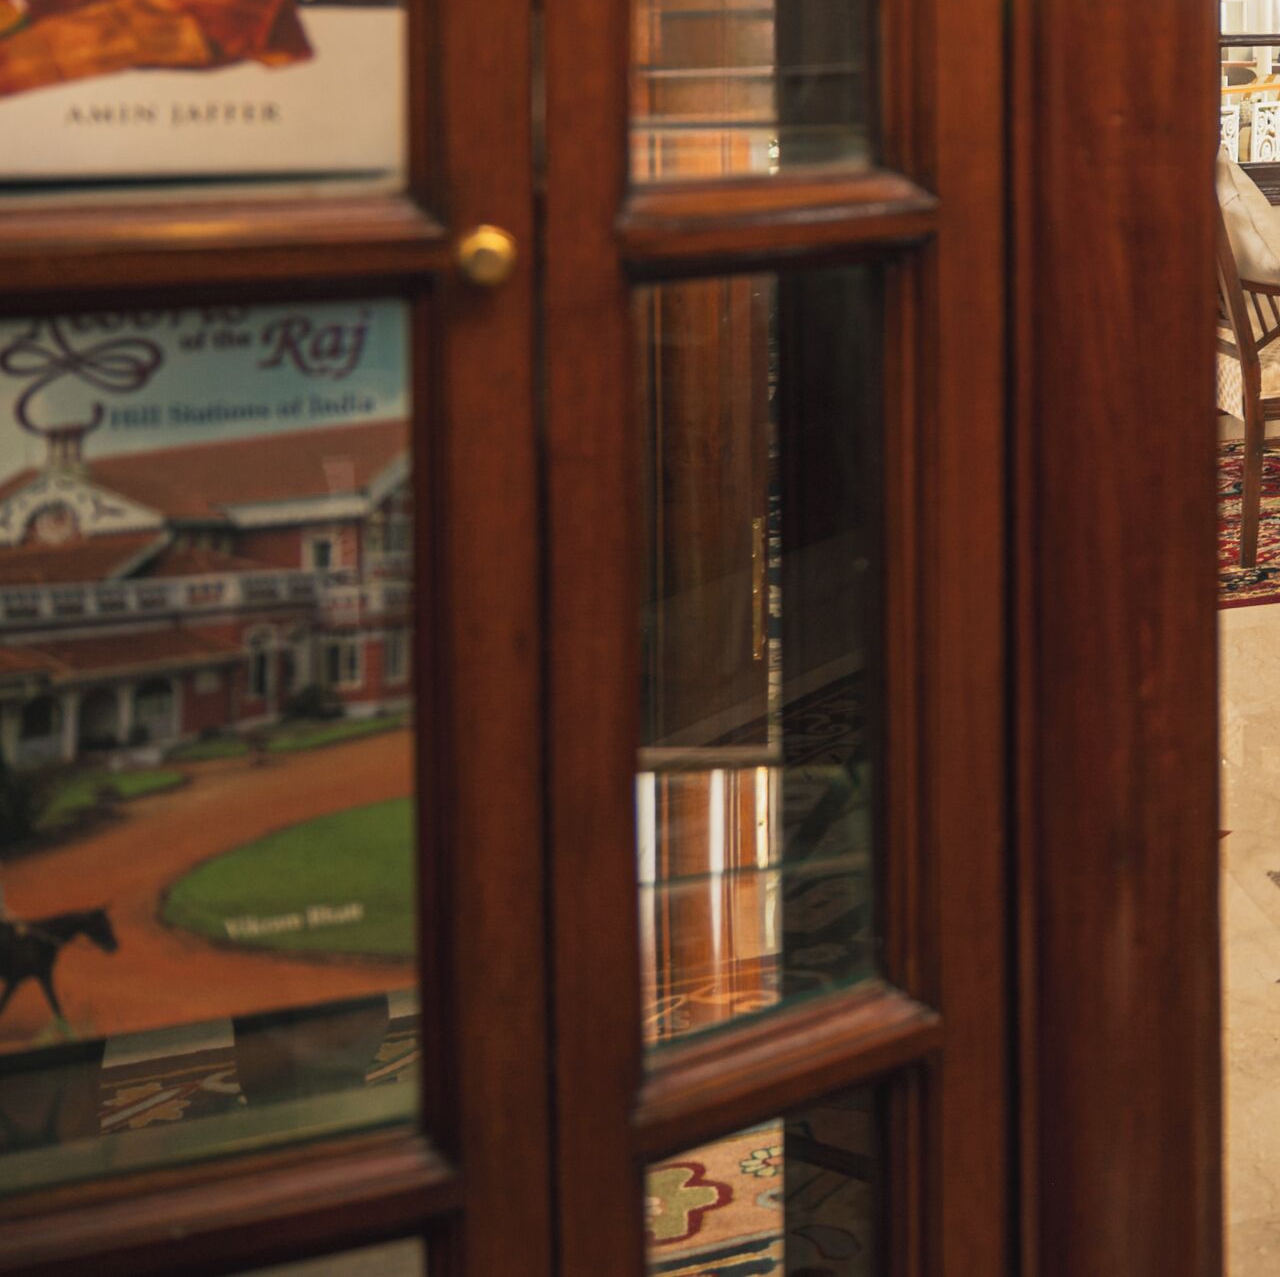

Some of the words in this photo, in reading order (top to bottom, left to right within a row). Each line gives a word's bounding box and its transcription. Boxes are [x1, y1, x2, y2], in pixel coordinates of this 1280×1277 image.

[65, 101, 158, 125] AMIN
[170, 101, 282, 126] JAFFER
[255, 307, 372, 380] Raj
